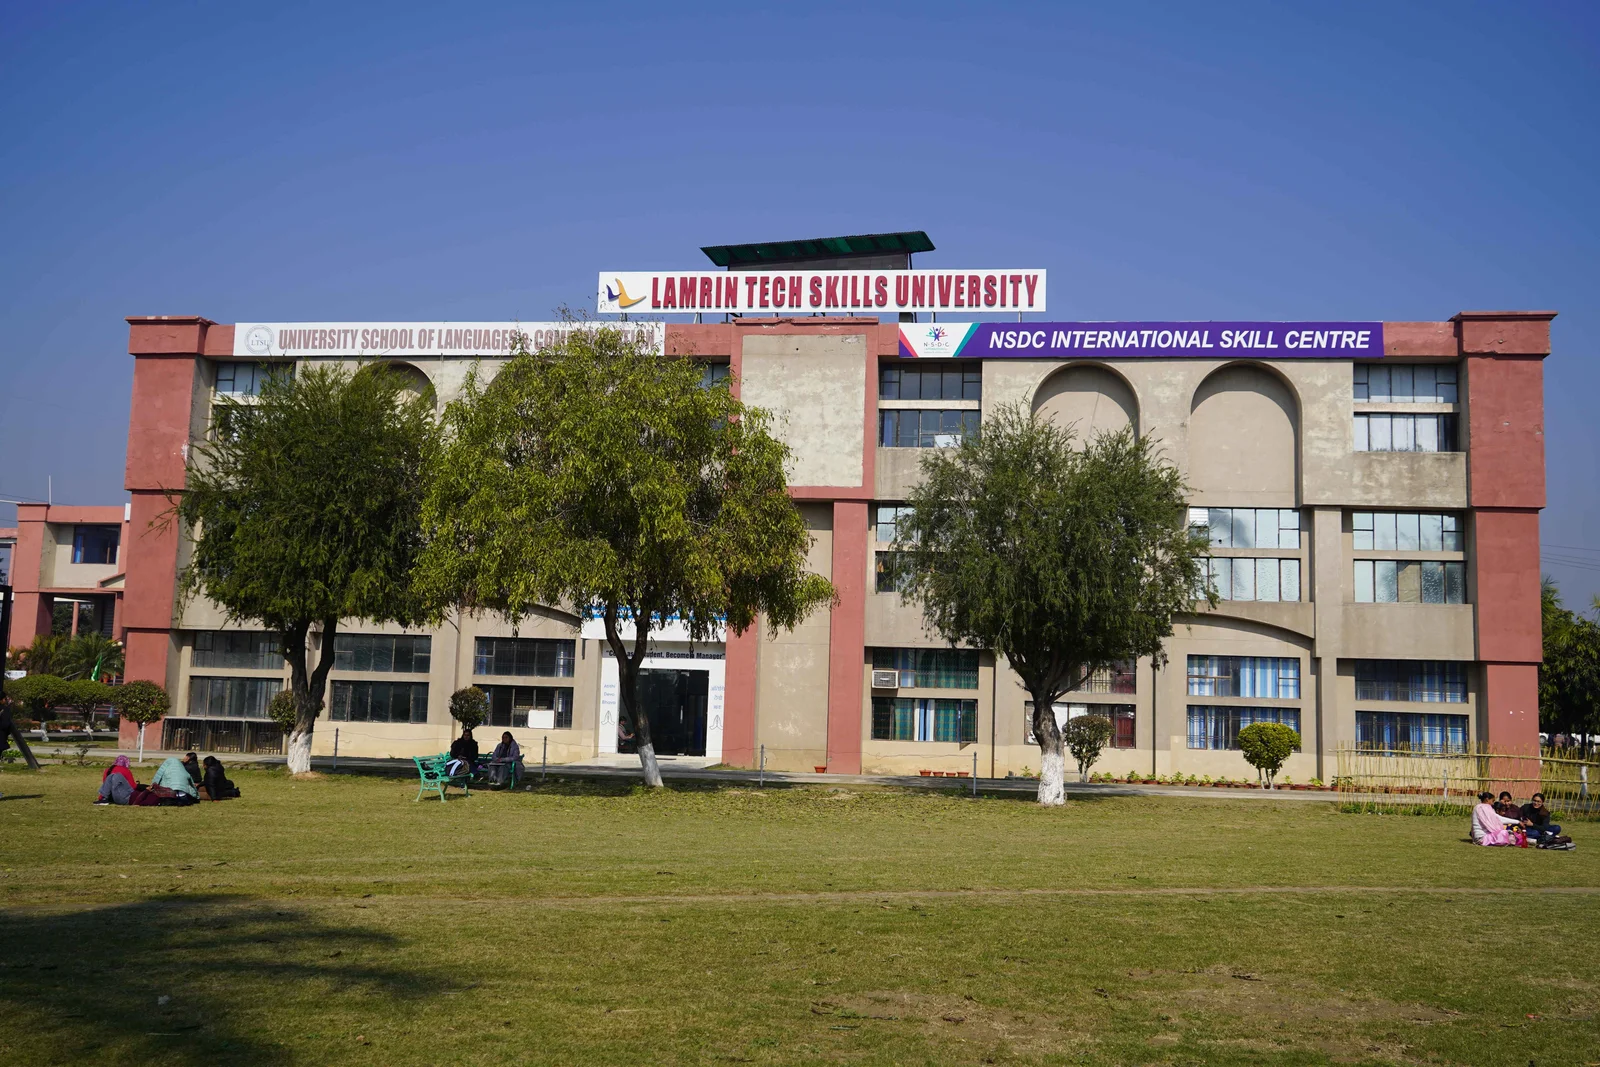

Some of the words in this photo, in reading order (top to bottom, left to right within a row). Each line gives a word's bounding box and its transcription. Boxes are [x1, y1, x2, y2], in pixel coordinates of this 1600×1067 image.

[651, 276, 739, 308] LAMRIN
[744, 276, 802, 308] TECH
[808, 275, 888, 308] SKILLS
[897, 274, 1039, 308] UNIVERSITY
[278, 328, 359, 350] UNIVERSITY
[360, 328, 414, 350] SCHOOL
[418, 328, 435, 350] OF
[437, 329, 517, 350] LANGUAGES
[989, 331, 1046, 349] NSDC
[1050, 330, 1214, 349] INTERNATIONAL
[1220, 330, 1278, 349] SKILL
[1284, 330, 1371, 349] CENTRE
